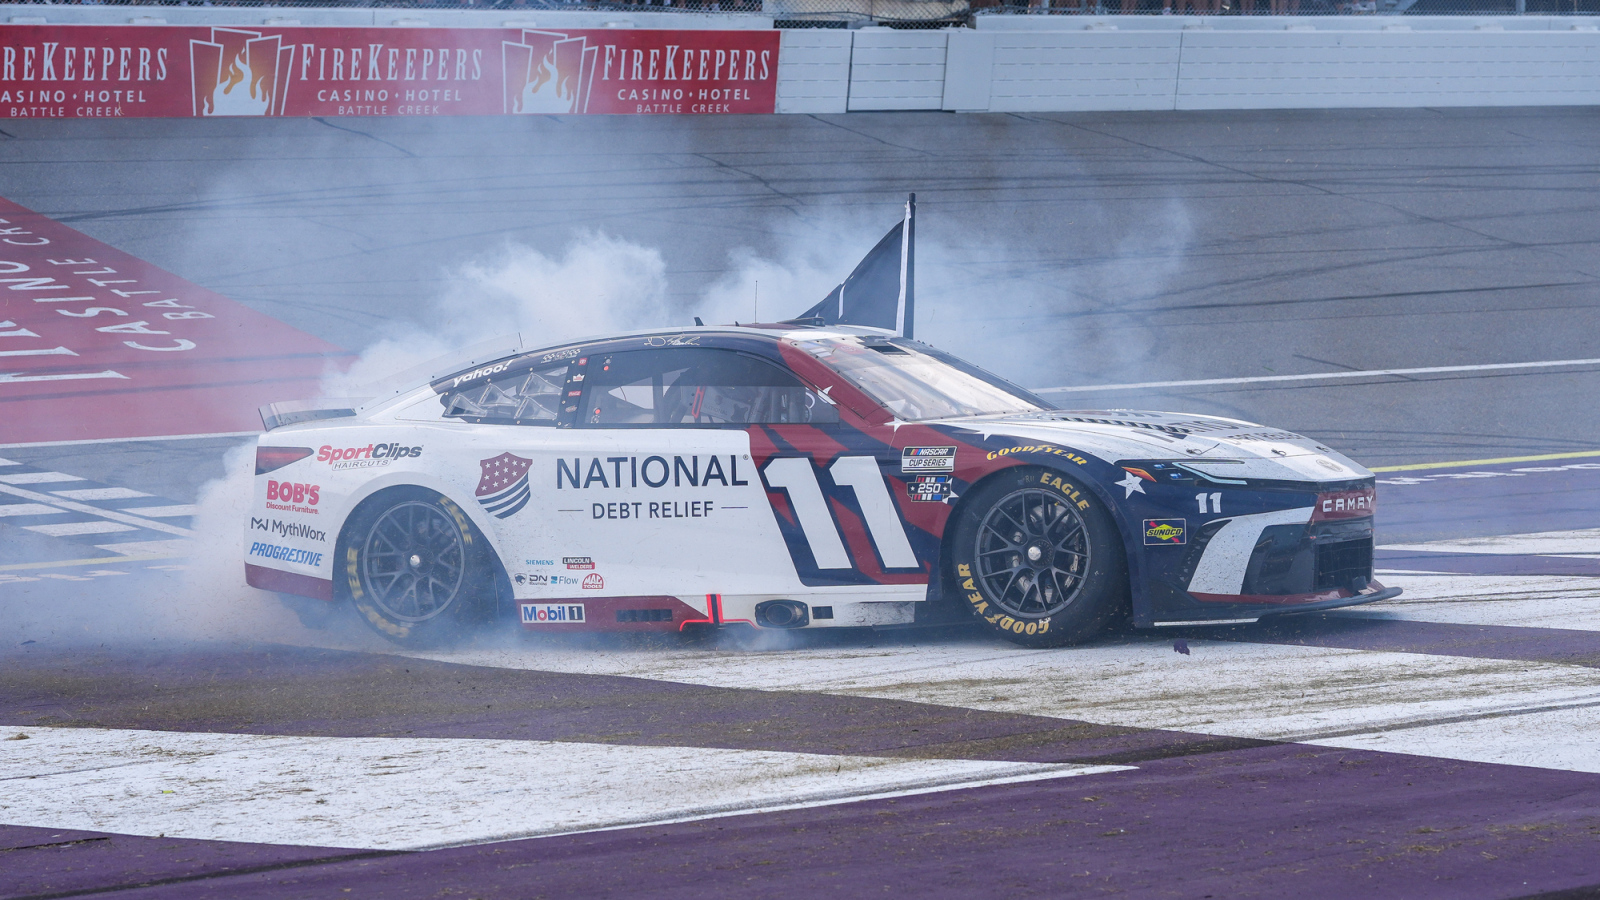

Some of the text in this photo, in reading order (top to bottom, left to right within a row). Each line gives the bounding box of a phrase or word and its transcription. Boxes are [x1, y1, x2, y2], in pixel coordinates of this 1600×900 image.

[300, 43, 482, 81] FIREKEEPERS
[602, 44, 770, 81] FIREKEEPERS
[84, 90, 147, 103] HOTEL
[317, 89, 462, 102] CASINO HOTEL
[617, 88, 751, 101] CASINO HOTEL
[10, 107, 123, 117] BATTLE CREEK
[338, 105, 440, 115] BATTLE CREEK
[636, 103, 730, 113] BATTLE CREEK
[46, 257, 216, 320] BATTLE
[452, 359, 514, 388] yahoo!
[316, 442, 424, 465] SportClips
[918, 448, 950, 456] NASCAR
[986, 443, 1088, 466] GOODYEAR
[334, 459, 389, 470] HAIRCUTS
[908, 458, 948, 467] CUP SERIES
[266, 480, 321, 506] BOB'S
[917, 483, 942, 494] 250
[1039, 472, 1091, 512] EAGLE
[265, 501, 292, 512] Discount
[592, 501, 715, 520] DEBT RELIEF
[1195, 492, 1223, 514] 11
[763, 456, 920, 570] 11
[271, 519, 327, 543] MythWorx
[1145, 527, 1184, 538] SUNOCO
[249, 541, 323, 567] PROGRESSIVE
[558, 575, 579, 585] Flow
[583, 574, 602, 585] MAC
[957, 562, 1051, 636] GOODYEAR
[522, 606, 567, 621] Mobil
